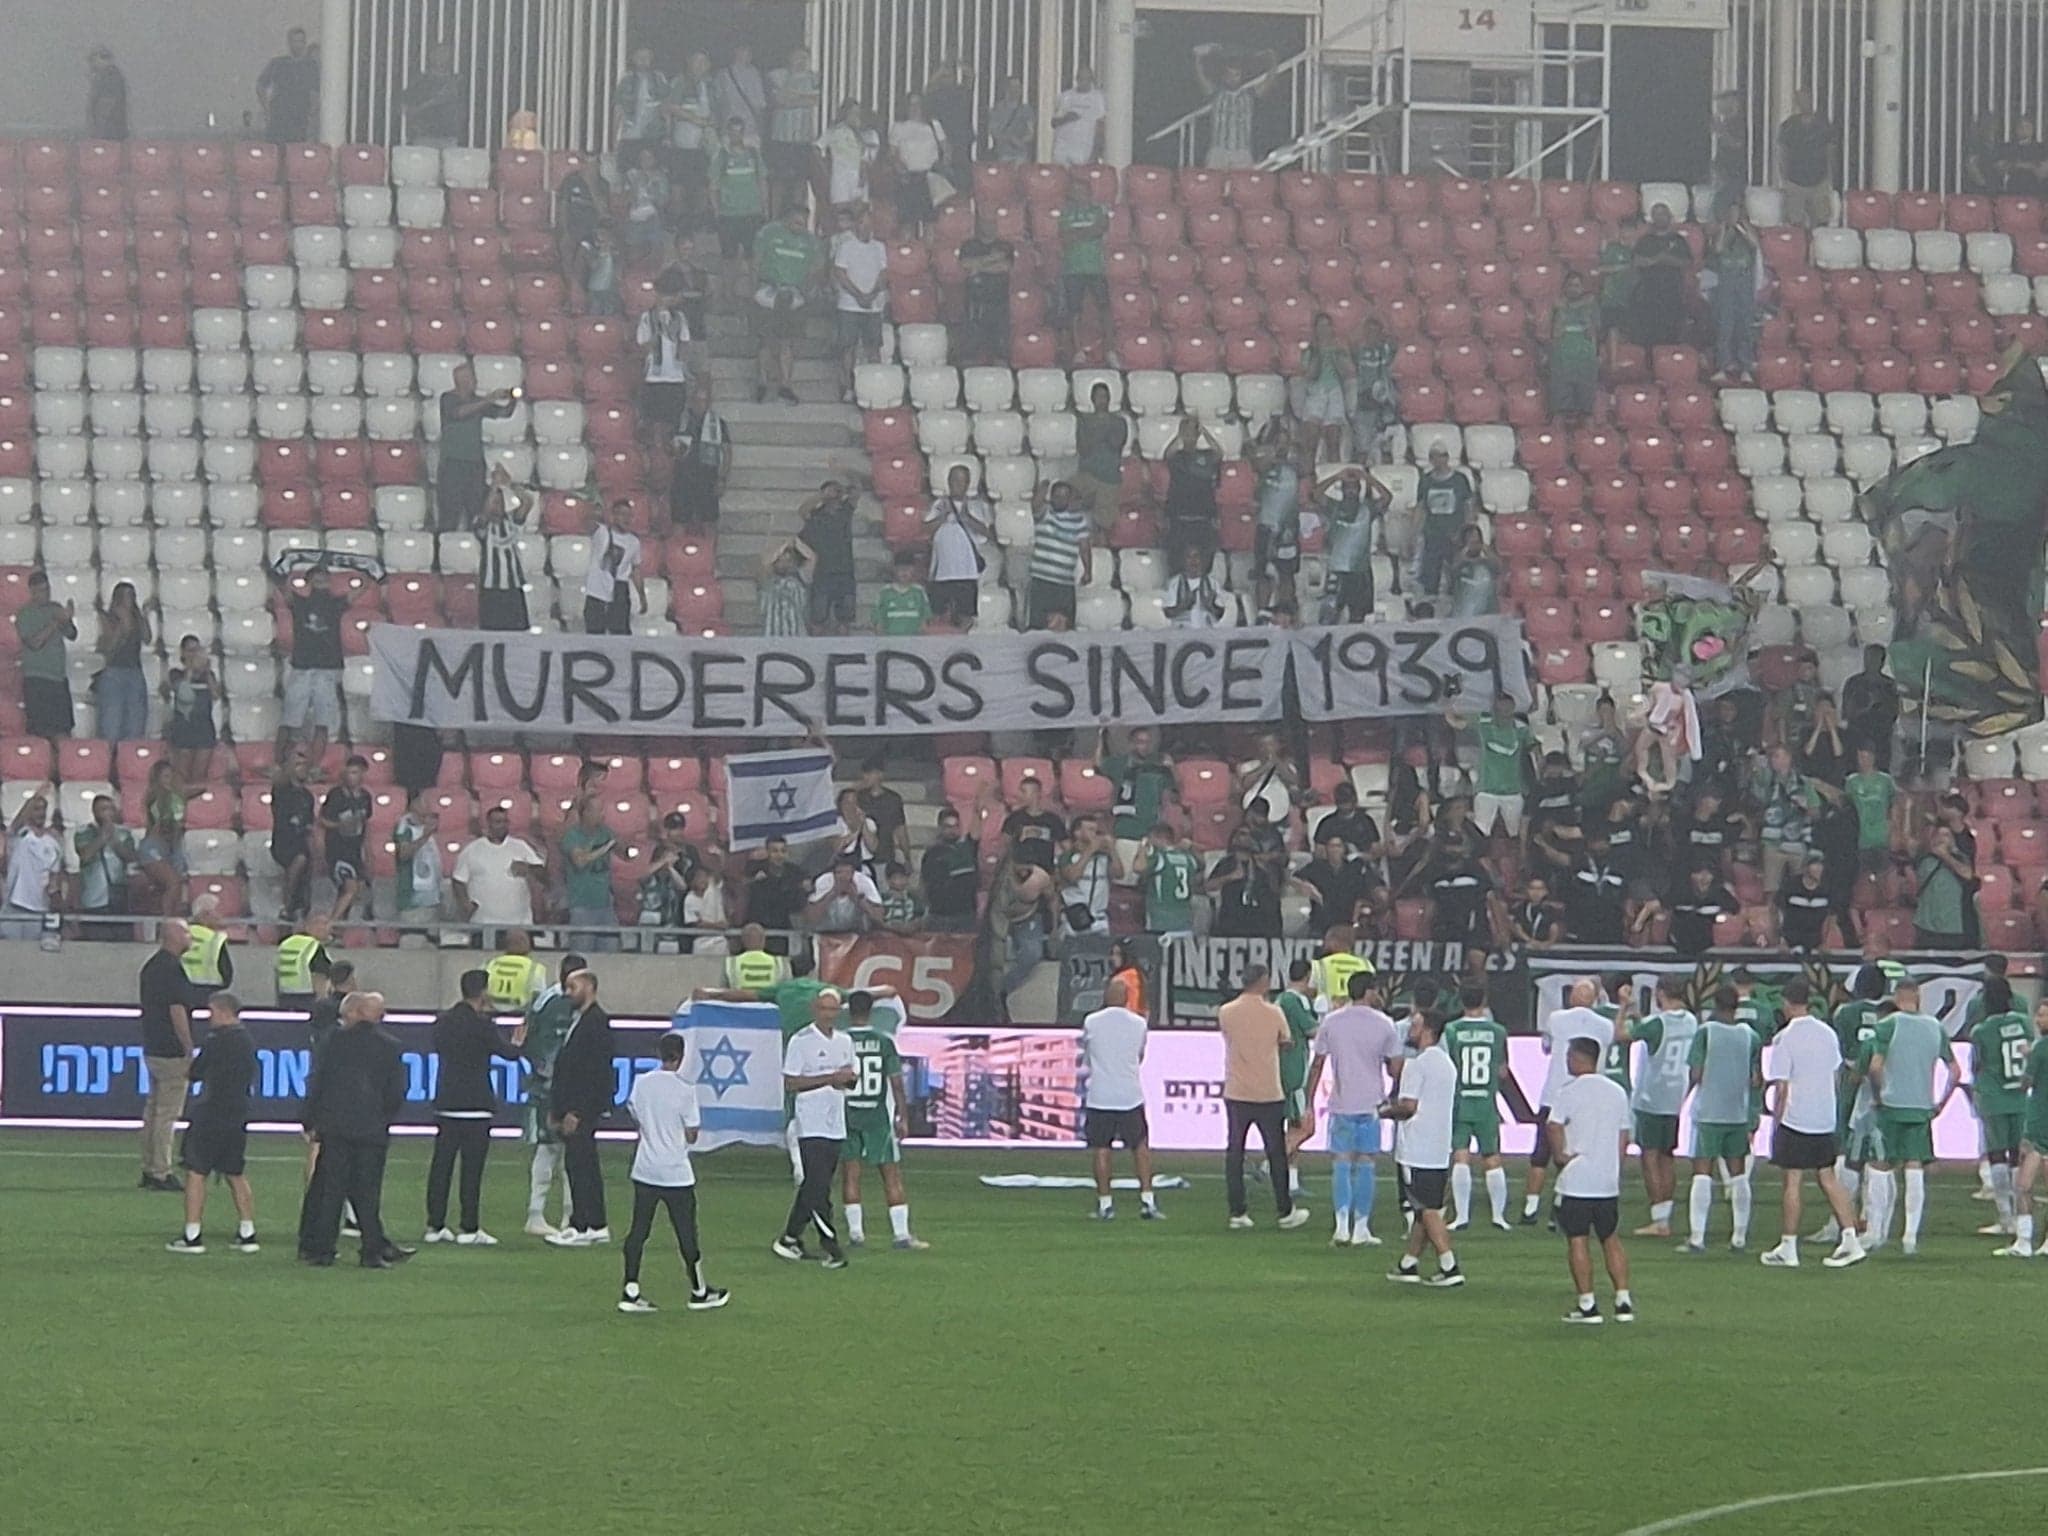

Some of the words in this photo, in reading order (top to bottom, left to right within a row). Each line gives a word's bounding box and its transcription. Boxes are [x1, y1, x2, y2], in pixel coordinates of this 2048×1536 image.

[1458, 9, 1496, 30] 14
[408, 637, 984, 729] MURDERERS
[1027, 639, 1270, 718] SINCE
[1311, 626, 1502, 712] 1939
[1174, 866, 1189, 899] 3
[1354, 939, 1434, 972] REEN
[1461, 1046, 1491, 1085] 18
[1663, 1038, 1688, 1076] 9
[2001, 1038, 2029, 1079] 15
